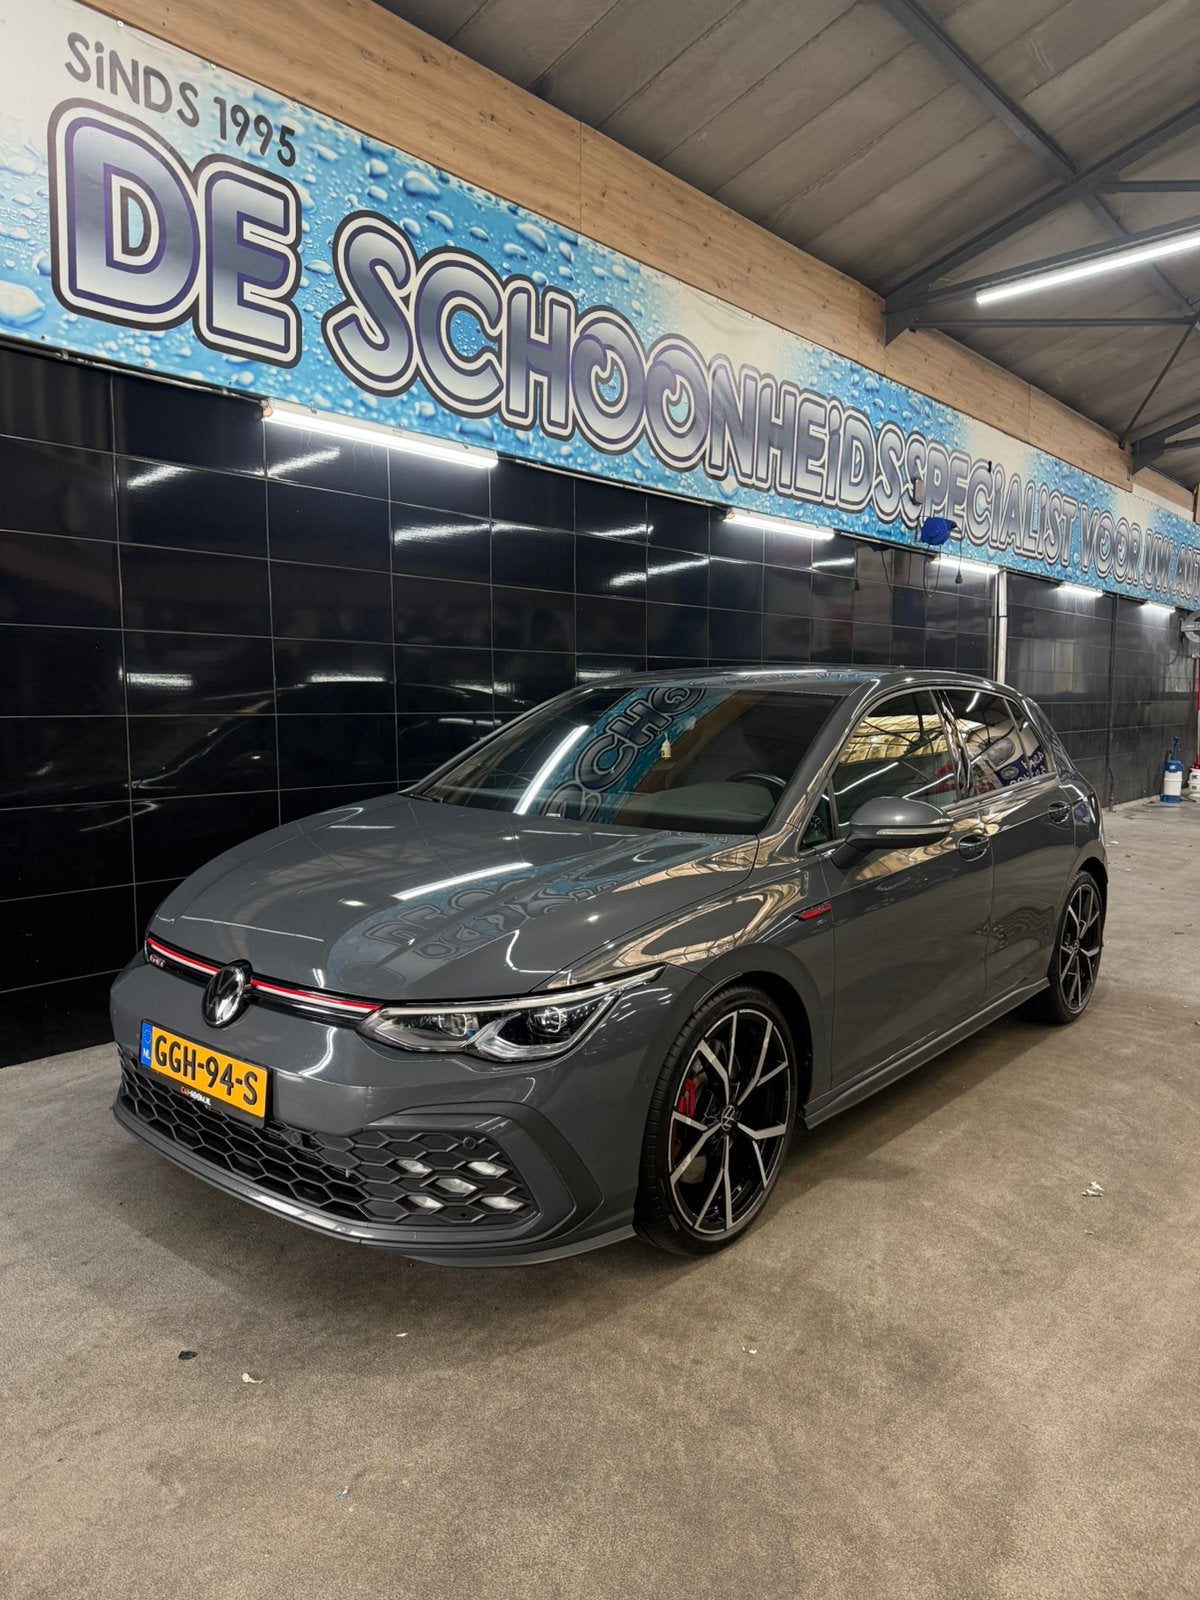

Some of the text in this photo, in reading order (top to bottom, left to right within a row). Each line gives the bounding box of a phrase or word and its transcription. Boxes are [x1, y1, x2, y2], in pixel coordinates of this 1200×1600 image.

[213, 96, 297, 168] 1995
[48, 97, 301, 370] DE
[1080, 501, 1143, 588] VOOR
[1144, 527, 1174, 593] UW
[154, 1035, 258, 1106] GGH-94-S
